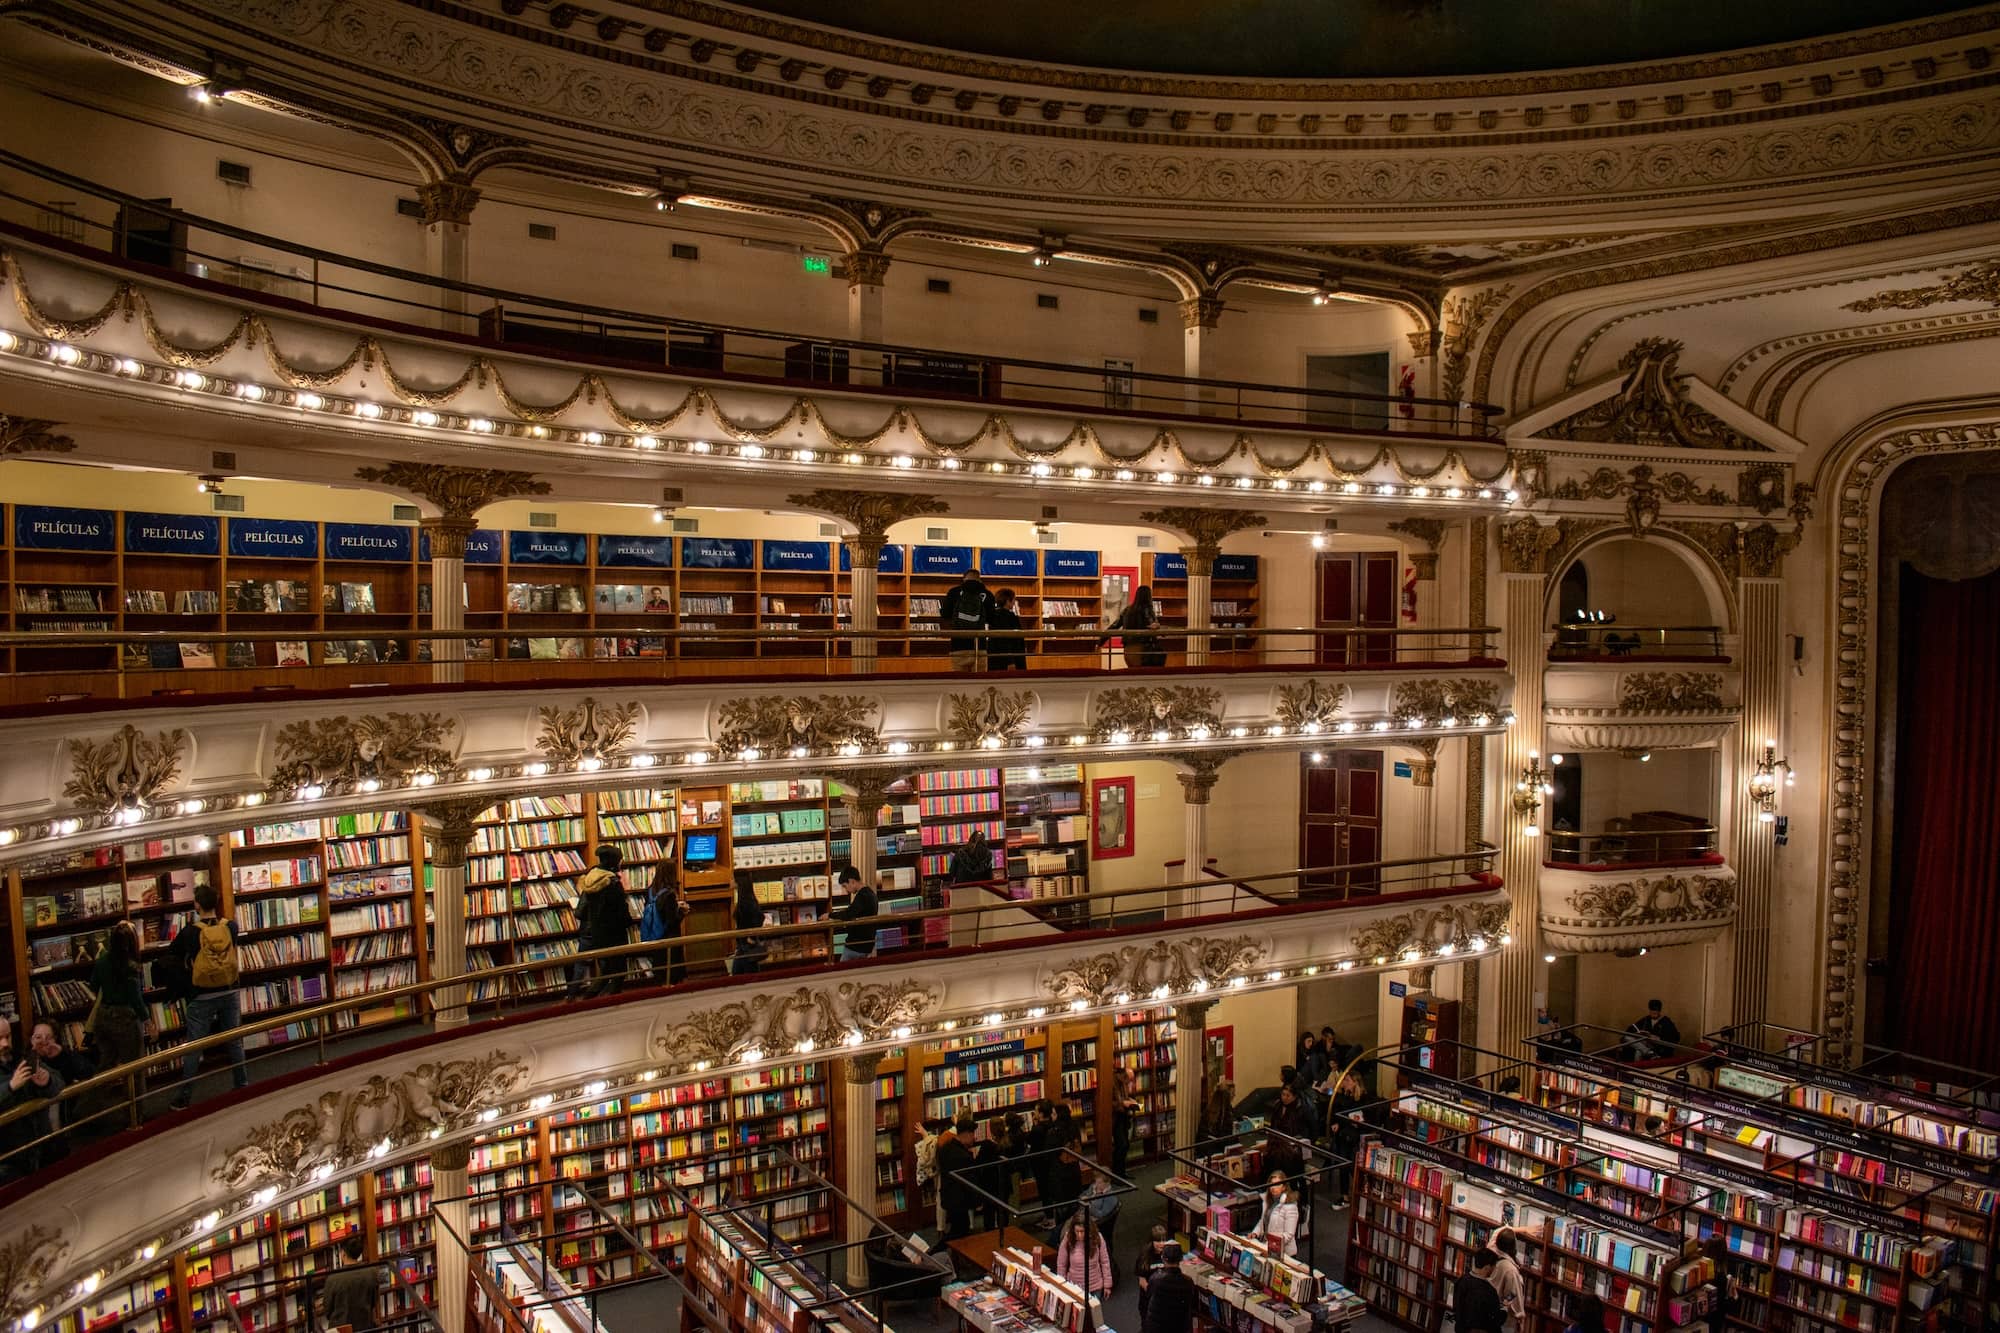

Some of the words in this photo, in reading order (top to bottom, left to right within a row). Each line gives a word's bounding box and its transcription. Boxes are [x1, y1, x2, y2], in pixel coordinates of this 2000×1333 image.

[33, 522, 99, 536] PELÍCULAS
[142, 527, 205, 541] PELÍCULAS
[244, 532, 304, 545] PELÍCULAS
[340, 536, 398, 548] PELÍCULAS
[530, 543, 568, 552] PELÍCULAS
[617, 547, 655, 555] PELÍCULAS
[701, 548, 736, 557] PELÍCULAS
[780, 551, 813, 560] PELÍCULAS
[959, 1050, 980, 1058] NOVELA
[981, 1044, 1012, 1054] ROMÁNTICA
[1925, 1160, 1970, 1177] OCULTISMO
